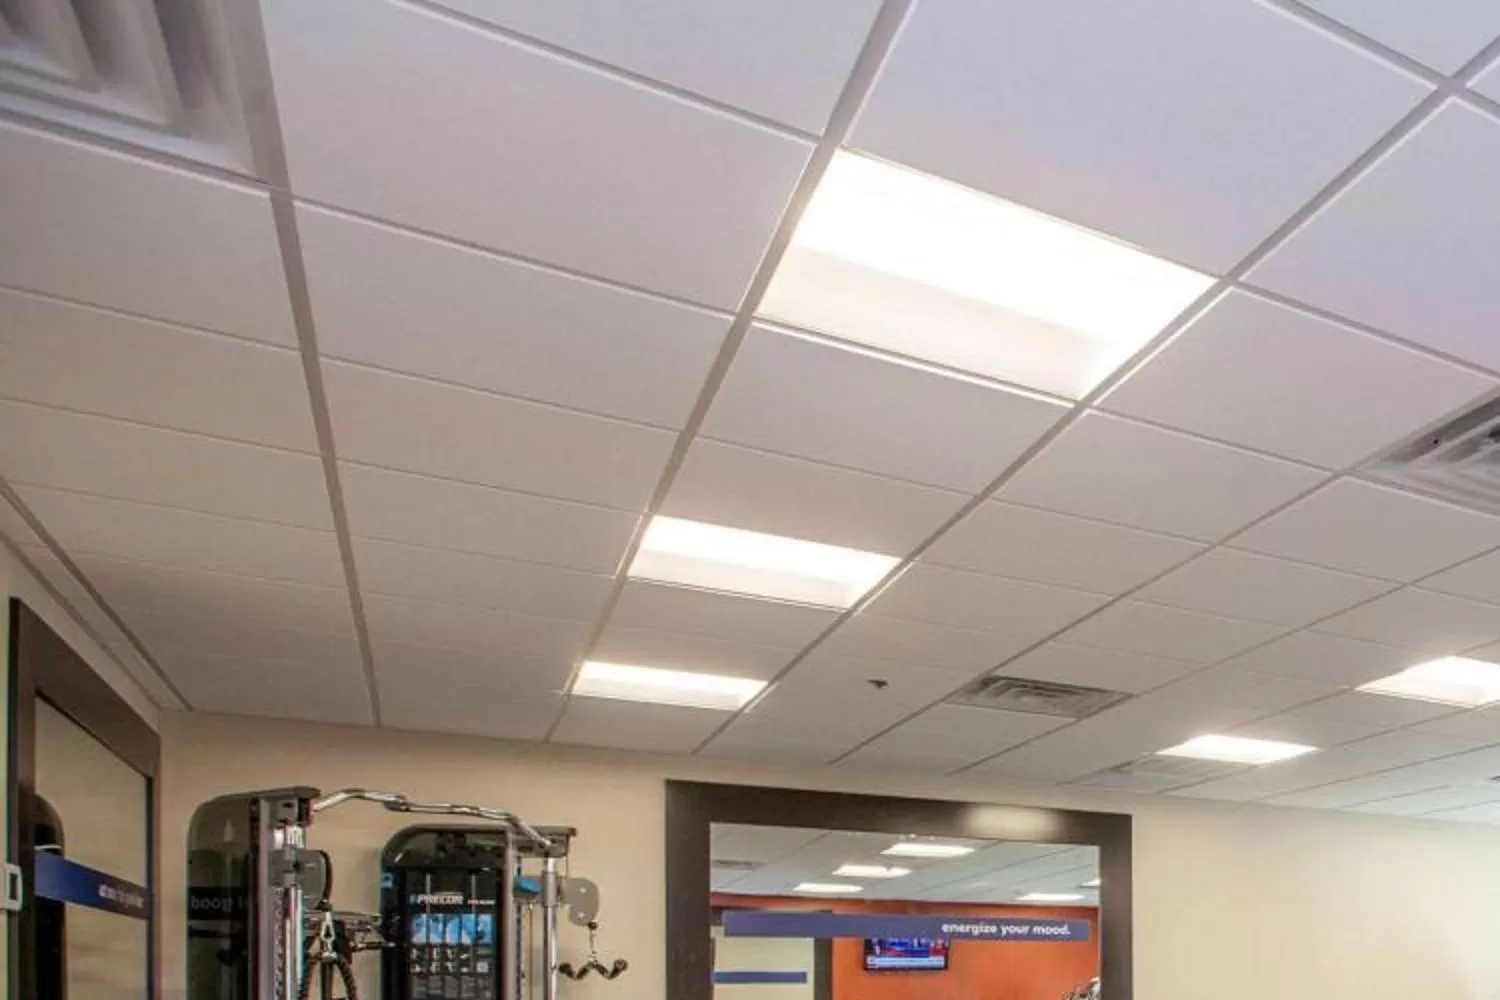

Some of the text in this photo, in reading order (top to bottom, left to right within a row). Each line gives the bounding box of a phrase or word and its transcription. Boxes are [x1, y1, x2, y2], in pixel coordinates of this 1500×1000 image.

[941, 922, 1071, 936] energize your mood.
